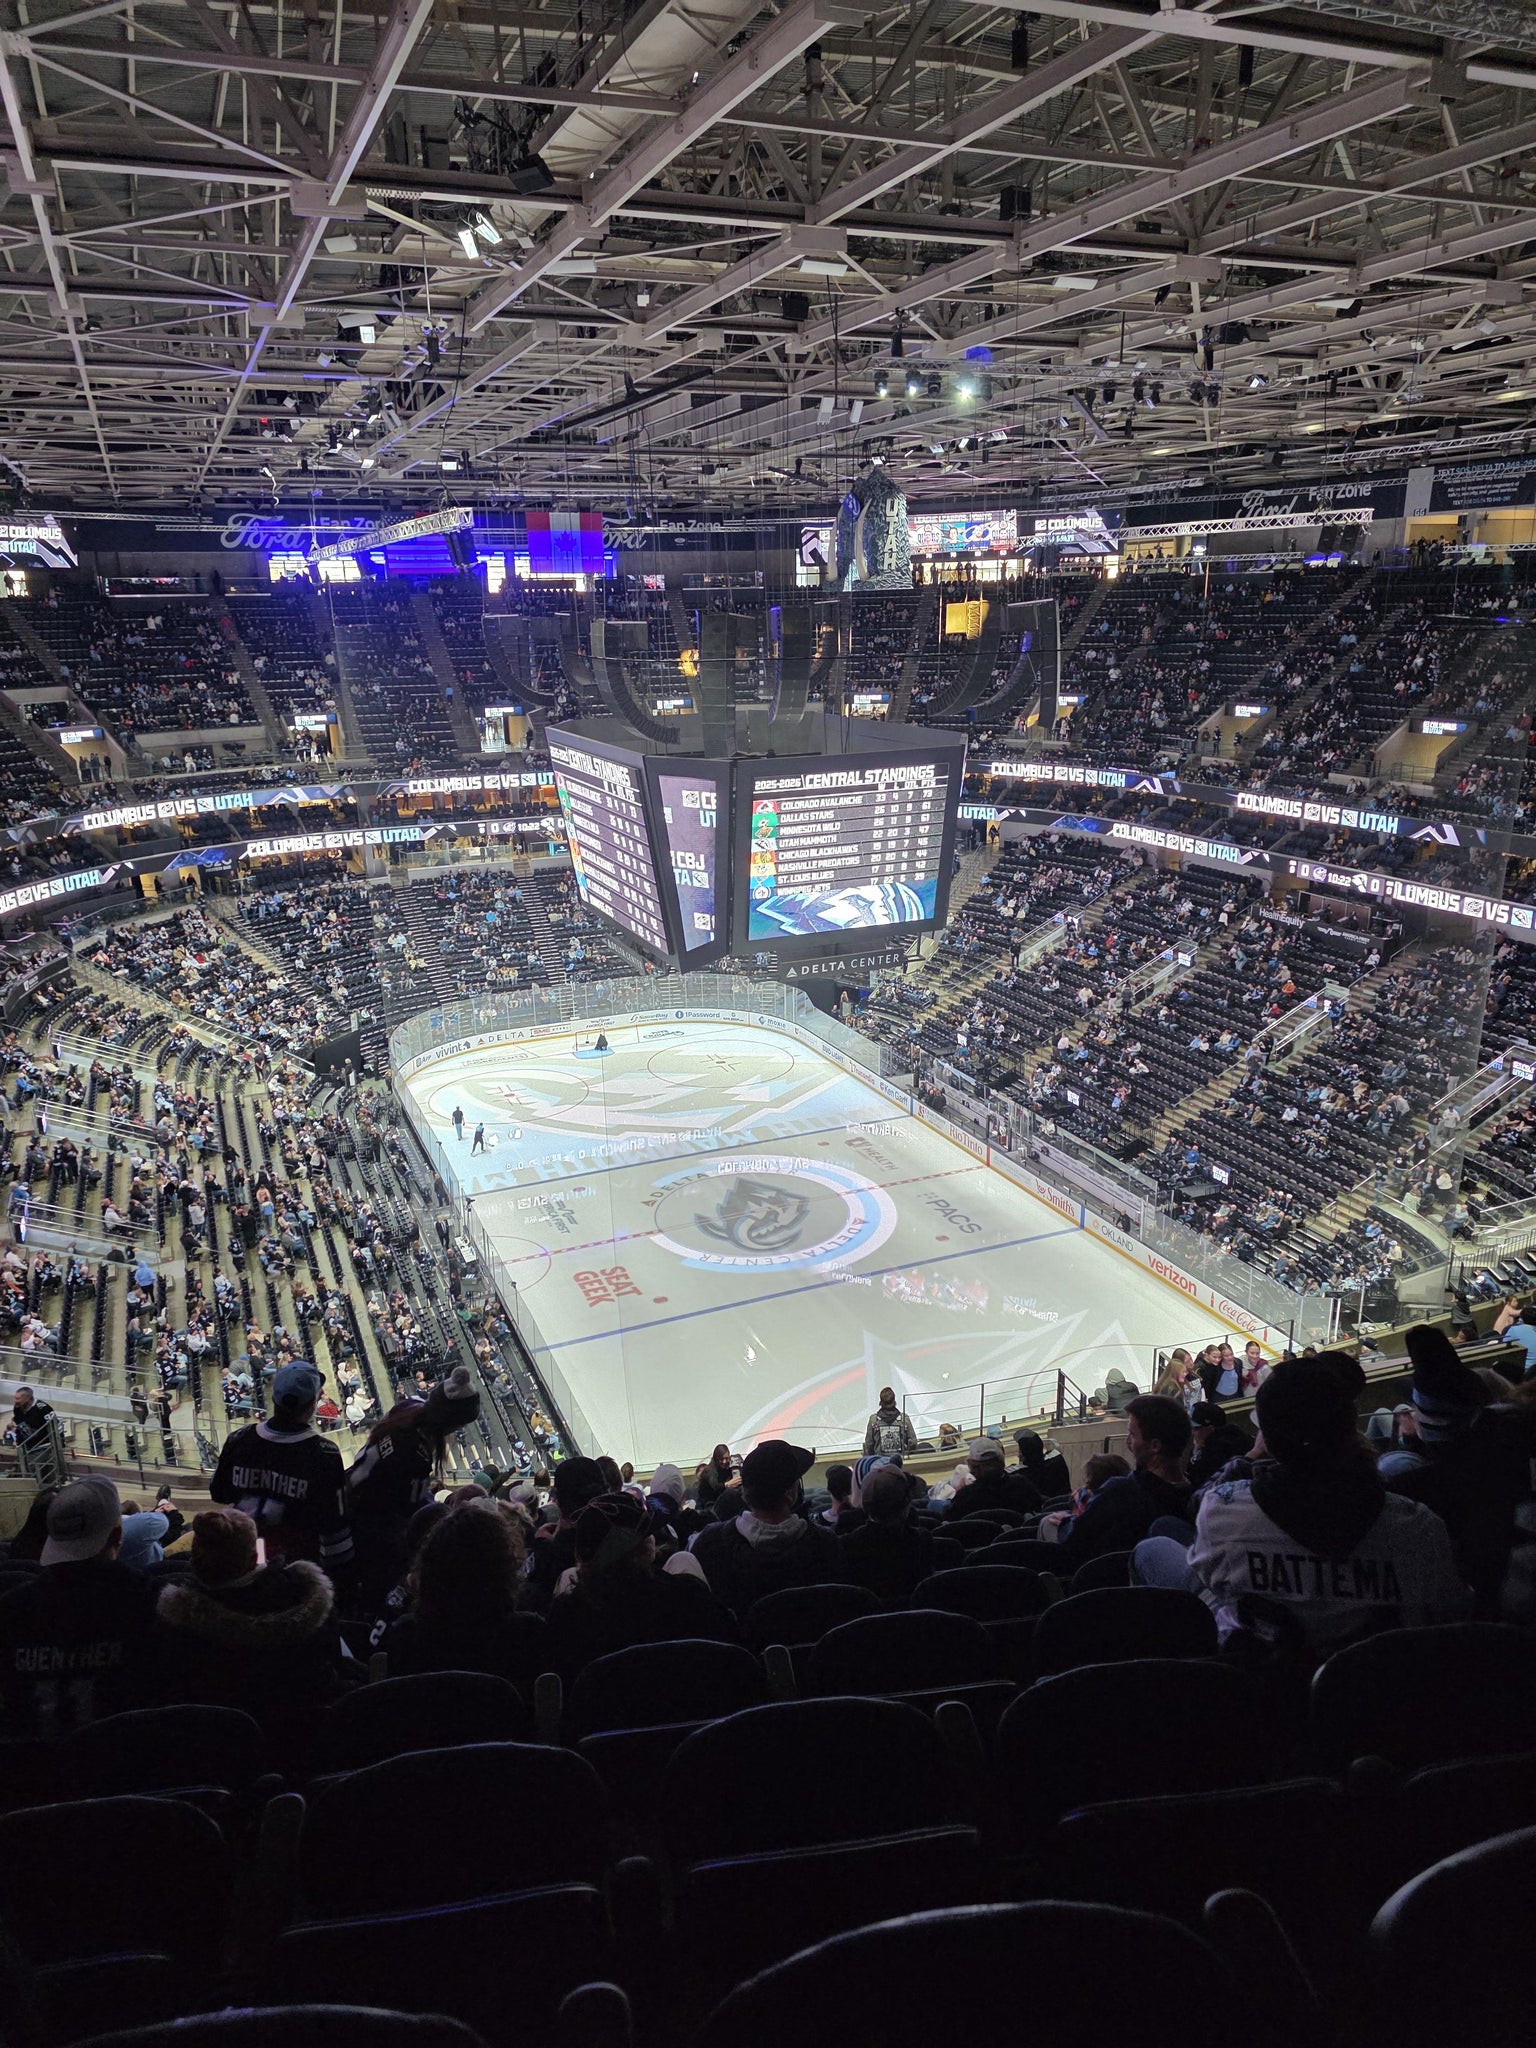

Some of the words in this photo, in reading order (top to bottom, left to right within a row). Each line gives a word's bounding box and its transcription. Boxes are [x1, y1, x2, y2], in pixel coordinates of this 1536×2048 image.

[1308, 486, 1335, 503] Fan
[1336, 482, 1372, 500] Zone
[1236, 489, 1299, 519] Ford
[9, 525, 62, 540] COLUMBUS
[220, 513, 306, 549] Ford
[320, 517, 350, 531] Fan
[353, 517, 388, 532] Zon
[660, 519, 686, 532] Fan
[687, 519, 721, 532] Zone
[884, 497, 898, 571] UTAH
[1048, 517, 1103, 530] COLUMBUS
[10, 541, 37, 553] UTAH
[408, 776, 482, 794] COLUMBUS
[500, 774, 520, 788] VS
[754, 777, 801, 791] 2025-2026
[805, 771, 863, 788] CENTRAL
[864, 765, 935, 783] STANDINGS
[877, 783, 886, 791] W
[921, 779, 936, 788] PTS
[991, 762, 1053, 779] COLUMBUS
[1069, 768, 1085, 782] VS
[1099, 771, 1126, 787] UTAH
[84, 803, 157, 830] COLUMBUS
[175, 798, 197, 815] VS
[214, 792, 254, 809] UTAH
[780, 800, 819, 811] COLORADO
[819, 796, 863, 808] AVALANCHE
[907, 791, 914, 799] 7
[780, 812, 810, 823] DALLAS
[810, 810, 834, 820] STARS
[963, 807, 996, 820] UTAH
[1237, 792, 1302, 818] COLUMBUS
[1321, 809, 1341, 825] VS
[1359, 811, 1399, 834] UTAH
[780, 825, 821, 836] MINNESOTA
[822, 822, 840, 832] WILD
[246, 834, 323, 857] COLUMBUS
[344, 832, 364, 847] VS
[382, 827, 421, 844] UTAH
[778, 849, 809, 860] CHICAGO
[809, 845, 859, 857] BLACKHAWKS
[779, 837, 801, 848] UTAH
[801, 835, 837, 846] MAMMOTH
[1113, 823, 1166, 847] COLUMBUS
[1180, 837, 1194, 853] VS
[1208, 844, 1239, 864] UTAH
[777, 860, 818, 872] NASHVILLE
[818, 856, 861, 868] PREDATORS
[32, 882, 50, 901] VS
[64, 870, 100, 892] UTAH
[777, 875, 791, 884] ST.
[792, 872, 811, 883] LOUIS
[811, 870, 835, 881] BLUES
[1327, 872, 1351, 887] 10:22
[1258, 907, 1305, 930] HealthEquity
[1486, 902, 1509, 923] VS
[801, 961, 846, 975] DELTA
[850, 953, 900, 968] CENTER
[685, 1010, 721, 1019] 1Password
[767, 1018, 787, 1028] moxie
[488, 1031, 525, 1043] DELTA
[884, 1084, 896, 1098] Ken
[894, 1089, 909, 1108] Garff
[650, 1172, 710, 1199] DELTA
[1046, 1187, 1075, 1218] Smith's
[925, 1198, 982, 1234] PACS
[802, 1226, 863, 1258] DELTA
[1101, 1224, 1134, 1253] OKLAND
[699, 1253, 791, 1267] CENTER
[599, 1266, 643, 1297] SEAT
[1147, 1254, 1198, 1297] verizon
[573, 1270, 616, 1308] GEEK
[232, 1465, 308, 1499] GUENTHER
[1248, 1551, 1402, 1600] BATTEMA
[15, 1641, 123, 1672] GUENTHER
